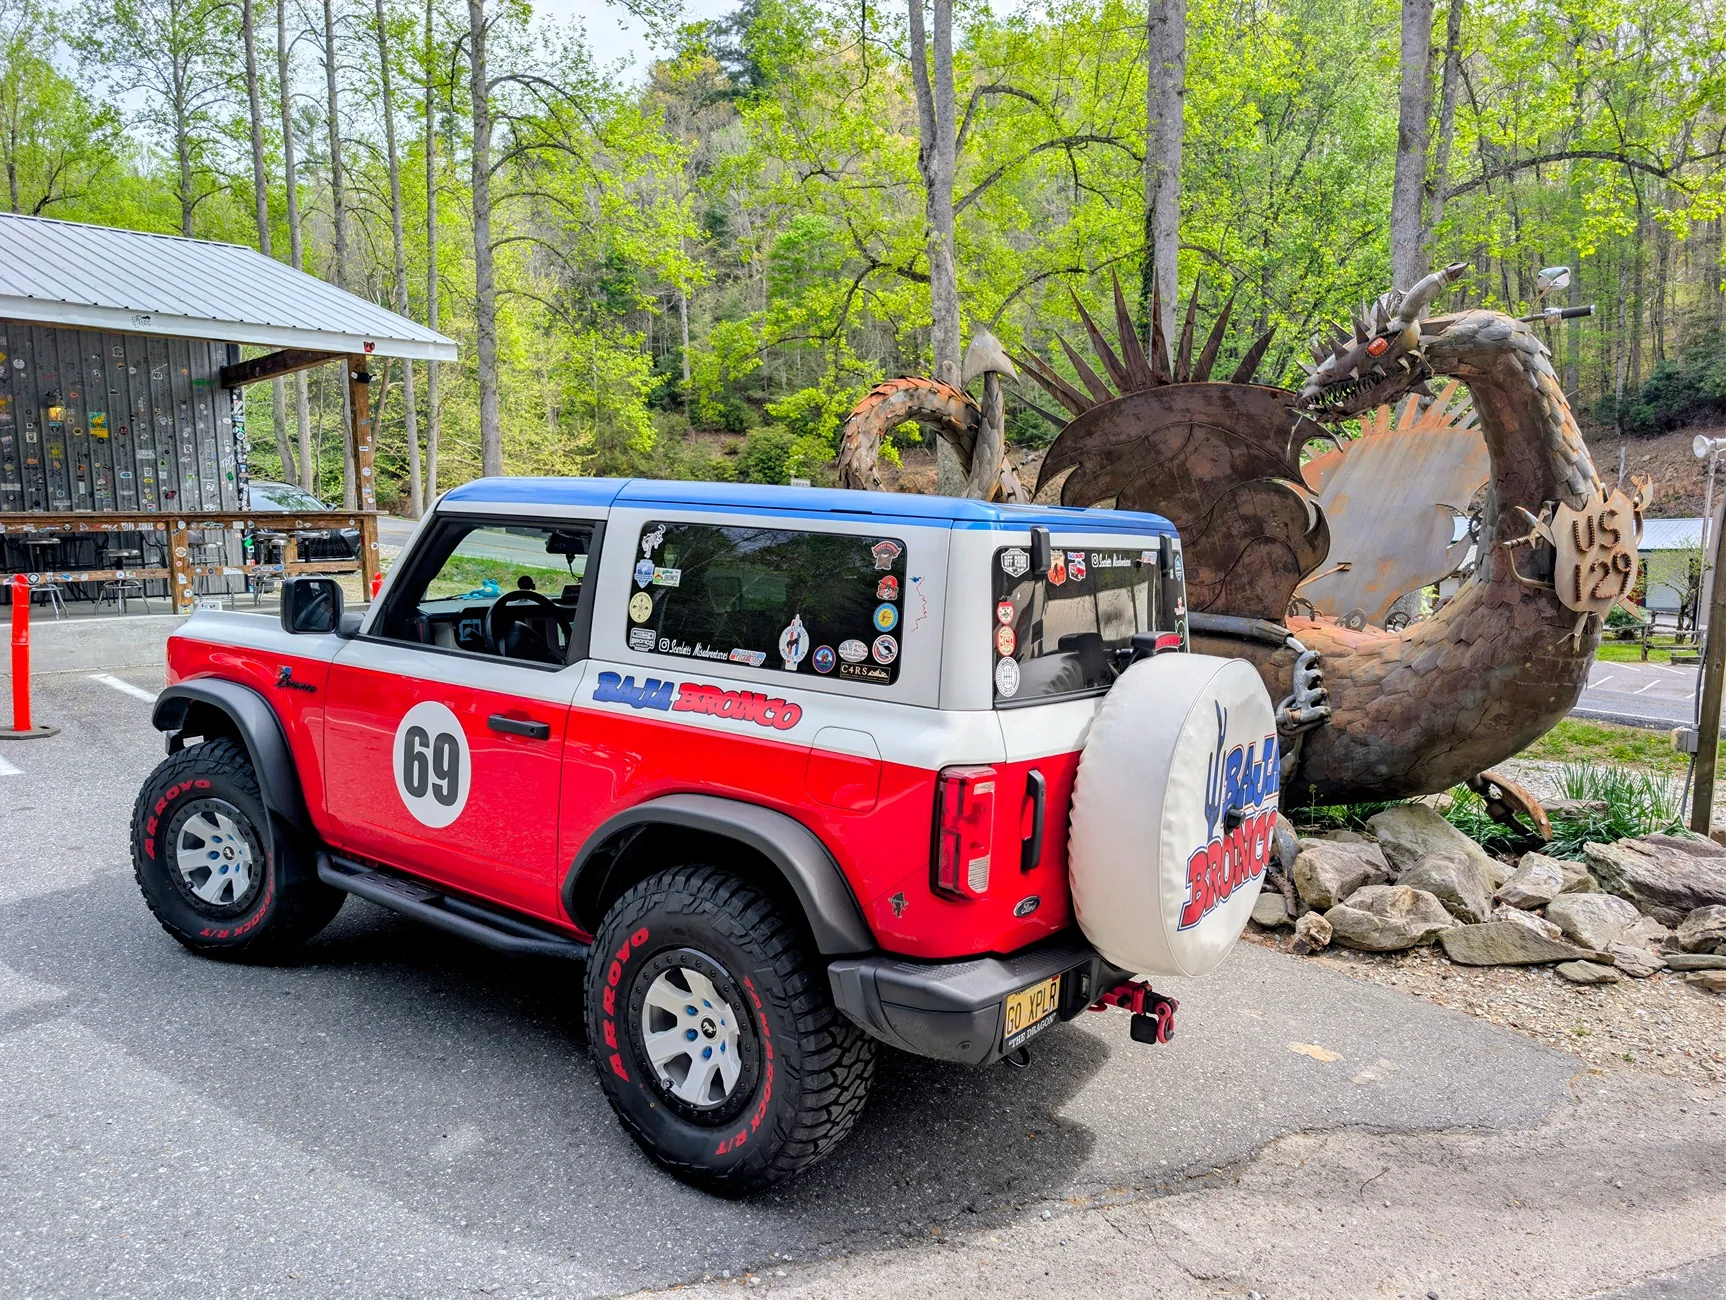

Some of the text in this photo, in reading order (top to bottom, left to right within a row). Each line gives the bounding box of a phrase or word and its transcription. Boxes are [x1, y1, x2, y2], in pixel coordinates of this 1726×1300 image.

[1572, 509, 1621, 552] US
[1574, 550, 1632, 603] 129
[841, 664, 868, 676] C4RS
[592, 671, 803, 730] BAJA BRONCO
[403, 725, 460, 807] 69
[1221, 735, 1279, 826] BAJA
[144, 779, 212, 860] ARROYO
[1178, 807, 1278, 930] BRONCO
[1021, 901, 1038, 915] Ford
[602, 927, 650, 1083] ARROYO
[1006, 1001, 1022, 1035] GO
[1028, 982, 1057, 1024] XPLR
[715, 1128, 748, 1156] R/T
